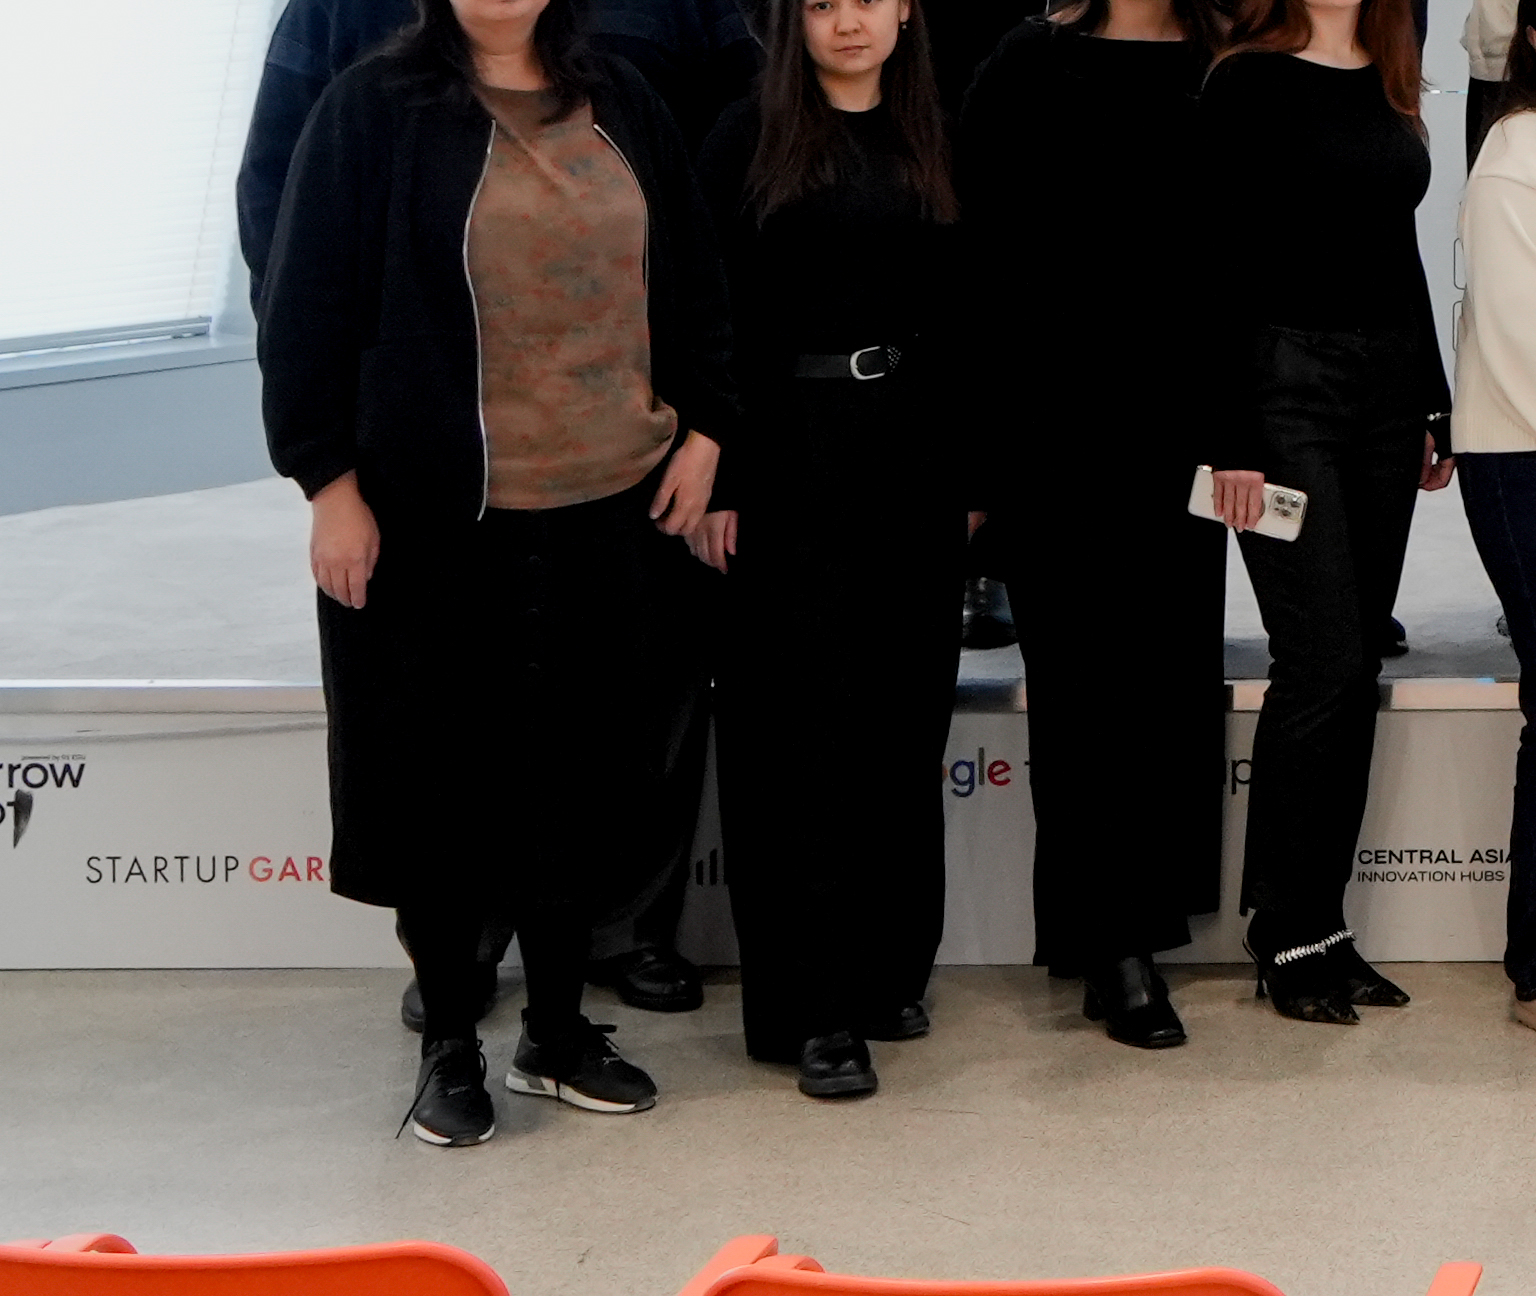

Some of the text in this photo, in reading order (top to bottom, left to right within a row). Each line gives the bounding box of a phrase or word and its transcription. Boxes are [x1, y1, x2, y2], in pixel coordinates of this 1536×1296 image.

[1357, 849, 1463, 865] CENTRAL
[86, 856, 329, 883] STARTUP GAR
[1357, 870, 1505, 883] INNOVATION HUBS
